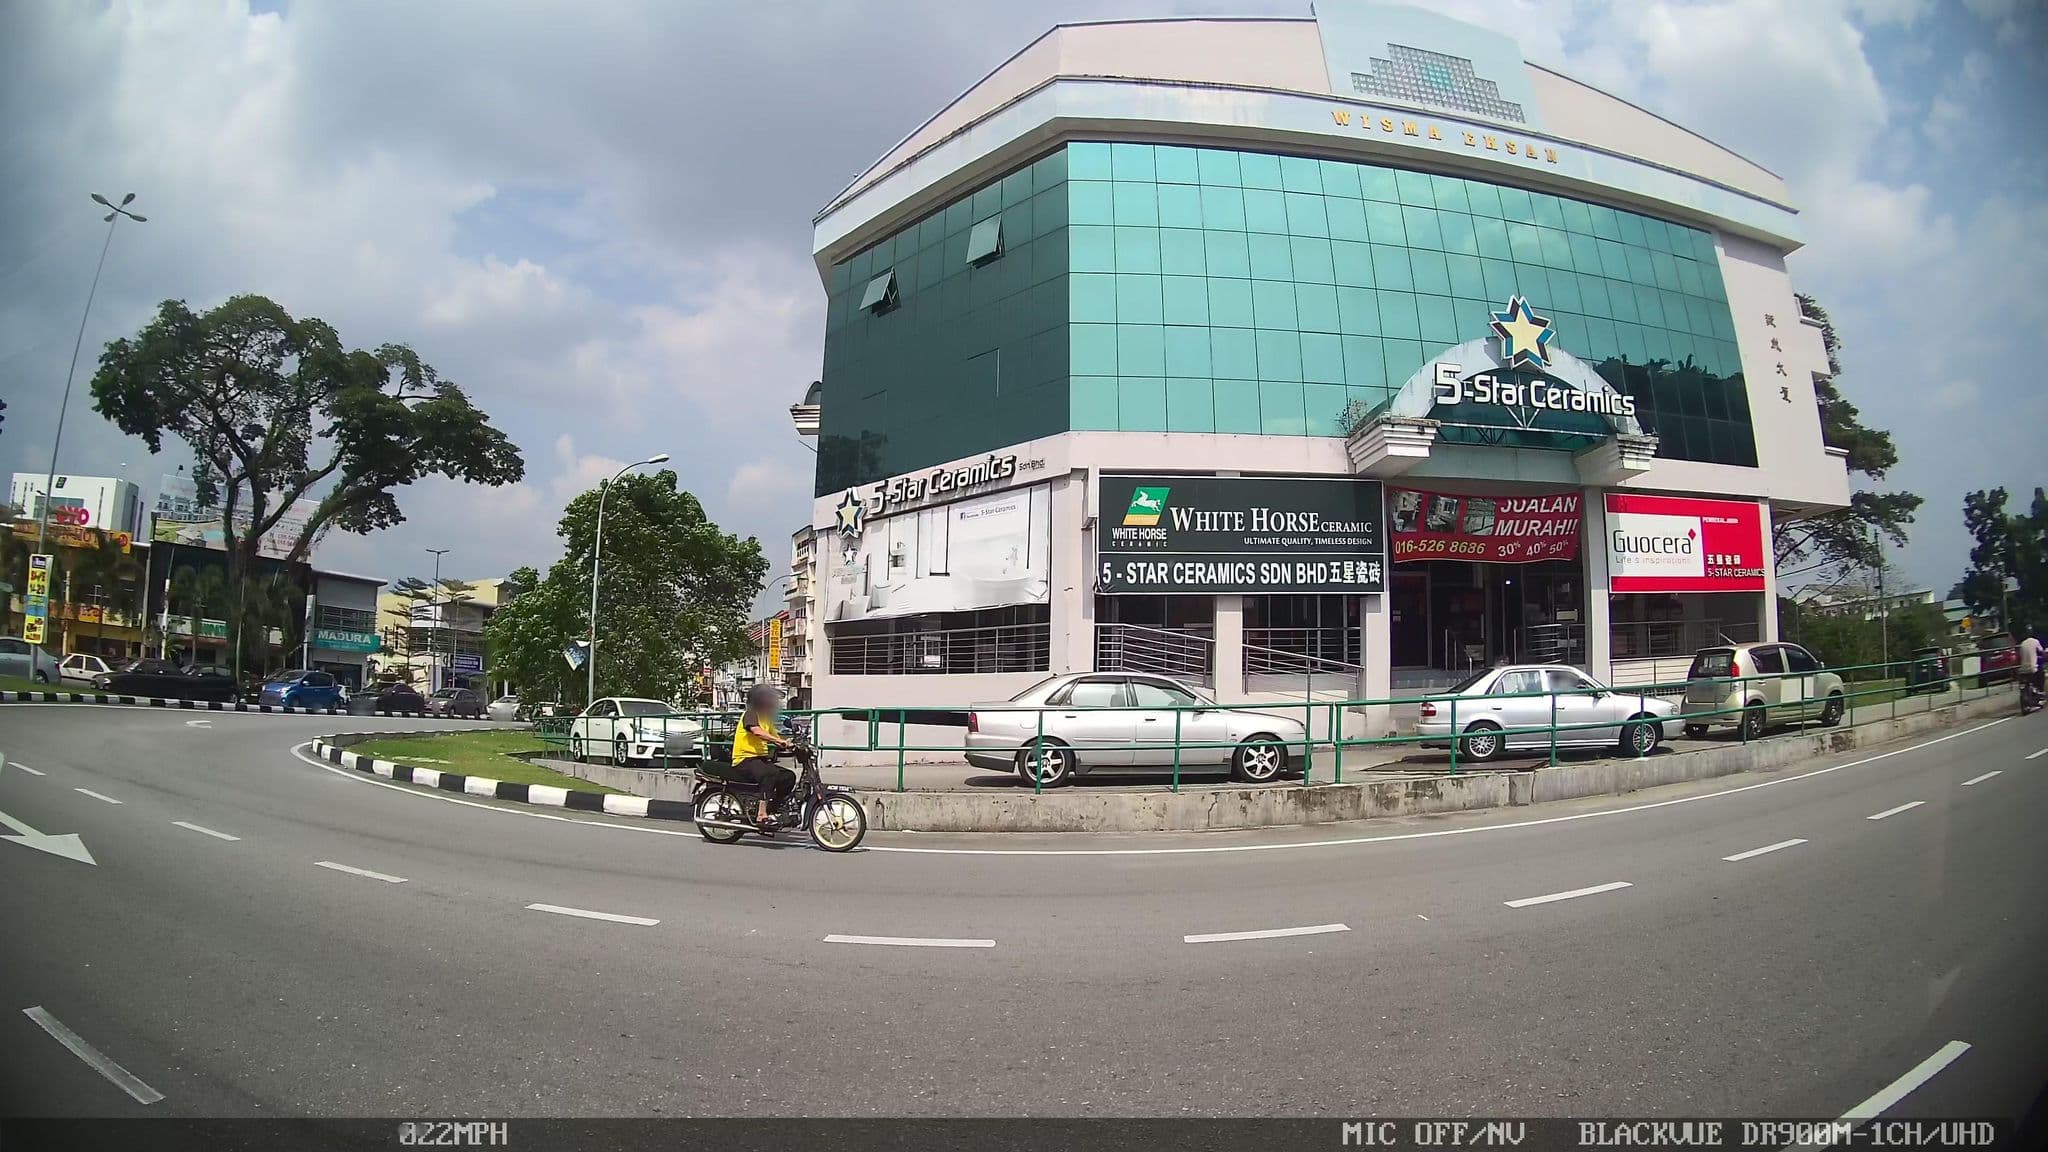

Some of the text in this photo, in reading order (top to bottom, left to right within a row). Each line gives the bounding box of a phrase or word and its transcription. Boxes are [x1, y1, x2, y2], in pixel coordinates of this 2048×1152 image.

[1331, 111, 1559, 164] WISMA EHSAN
[1434, 362, 1635, 417] 5-Star Ceramics
[868, 478, 927, 515] 5-Star
[929, 454, 1017, 494] Ceramics
[1500, 496, 1577, 513] JUALAN
[1170, 507, 1372, 533] WHITE HORSE CERAMIC
[1494, 519, 1578, 537] MURAH!!
[1112, 528, 1167, 540] WHITE HORSE
[1244, 537, 1280, 545] ULTIMATE
[1281, 537, 1313, 546] QUALITY,
[1314, 537, 1346, 545] TIMELESS
[1613, 529, 1692, 554] Guocera
[1395, 539, 1446, 554] 016-526
[1103, 562, 1112, 584] 5
[1126, 562, 1169, 584] STAR
[1173, 562, 1256, 585] CERAMICS
[1260, 562, 1291, 584] SDN
[1296, 562, 1327, 584] BHD
[1329, 560, 1381, 584] 五星瓷砖
[1734, 568, 1766, 577] CERAMICS
[318, 630, 371, 644] MADURA
